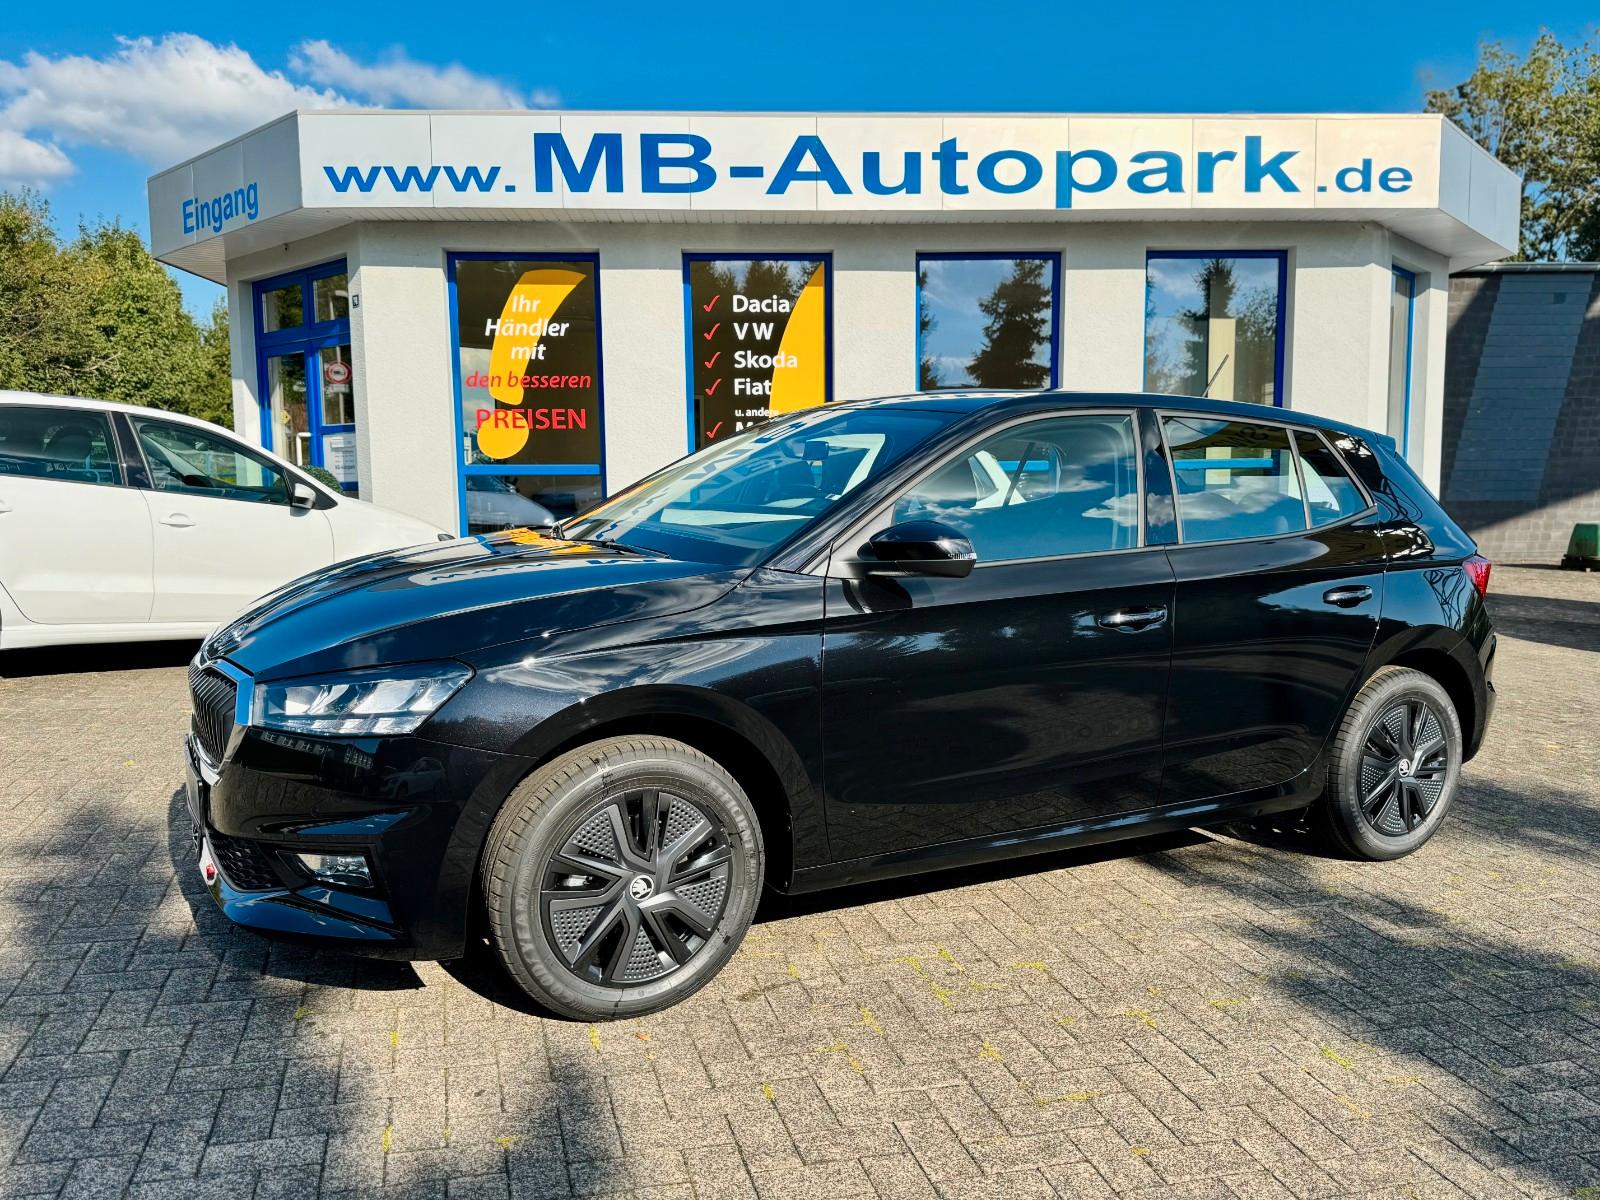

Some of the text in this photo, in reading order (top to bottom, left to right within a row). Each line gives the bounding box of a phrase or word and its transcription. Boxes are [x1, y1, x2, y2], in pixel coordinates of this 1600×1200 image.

[182, 182, 259, 234] Eingang
[511, 294, 541, 313] Ihr
[732, 294, 790, 313] Dacia
[484, 318, 570, 337] Händler
[510, 343, 547, 360] mit
[733, 350, 798, 369] Skoda
[465, 370, 592, 388] den besseren
[733, 378, 772, 396] Fiat
[475, 408, 588, 430] PREISEN
